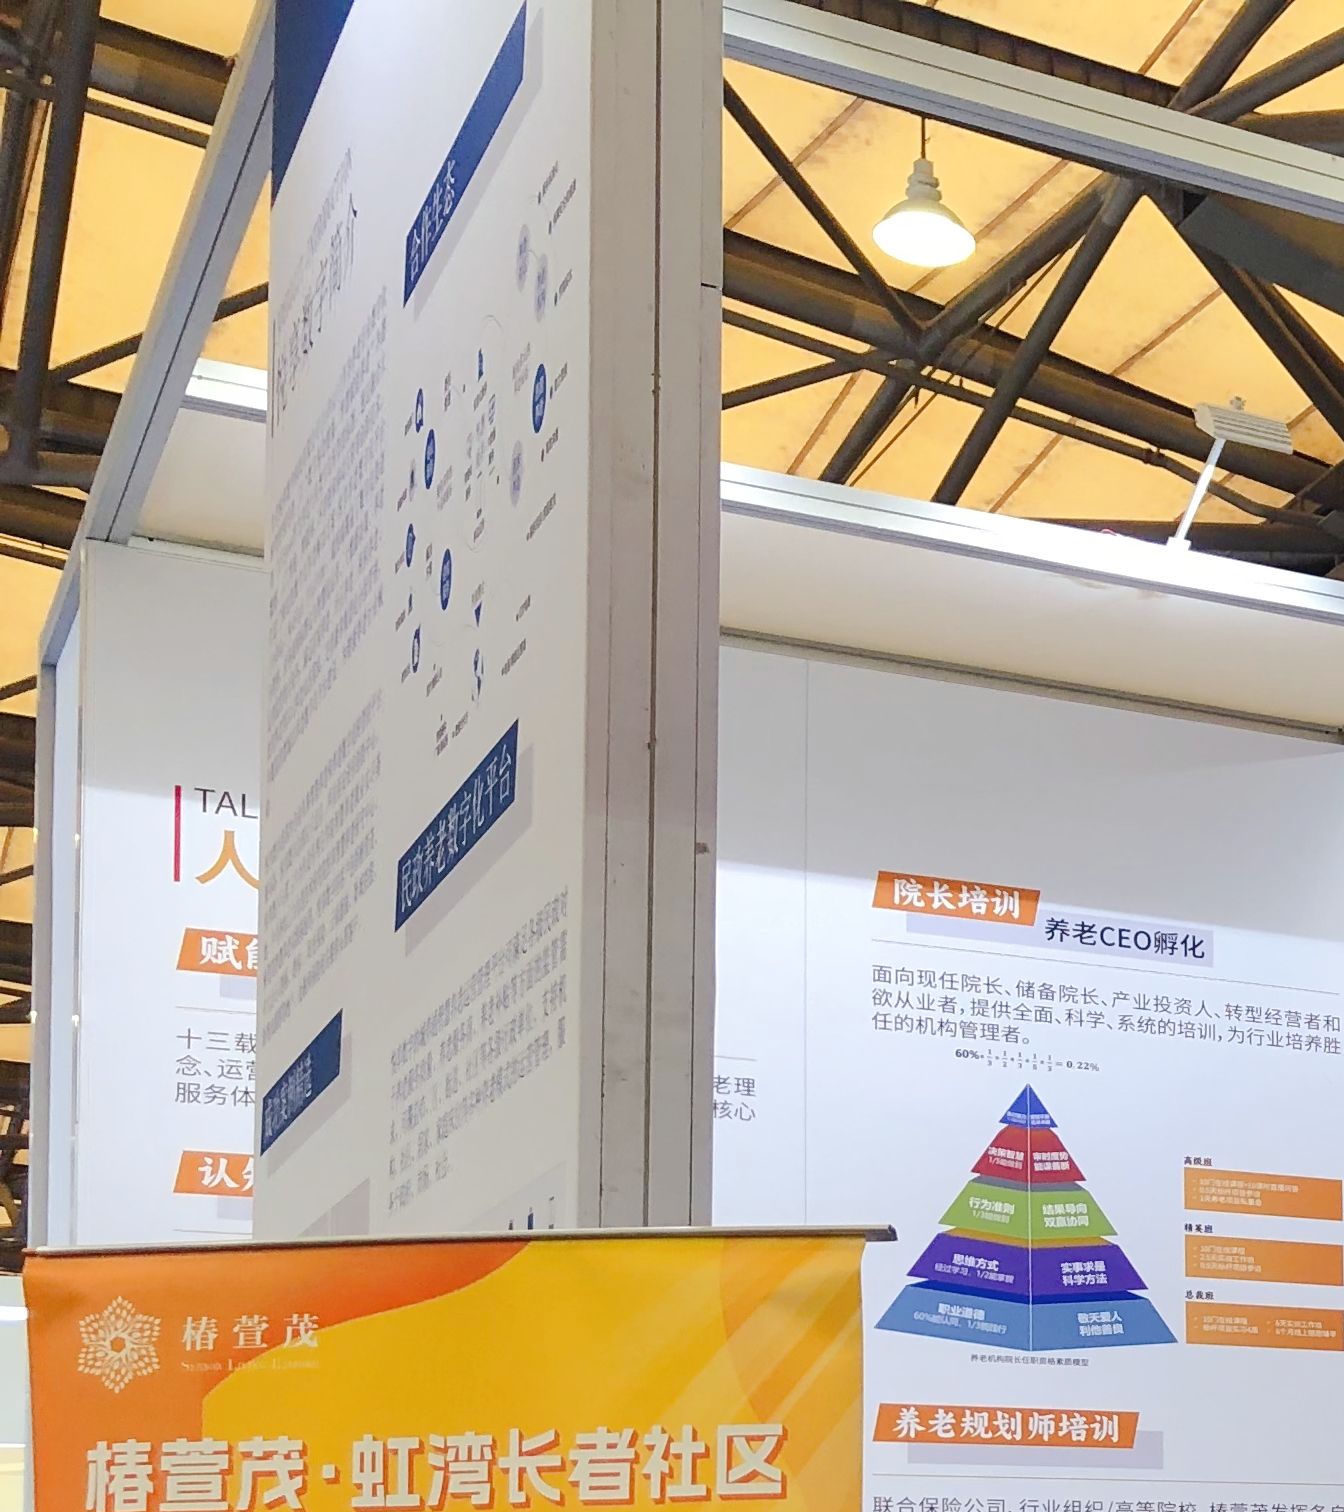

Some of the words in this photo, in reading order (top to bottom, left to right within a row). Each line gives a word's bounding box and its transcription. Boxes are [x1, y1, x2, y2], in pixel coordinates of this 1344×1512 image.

[401, 744, 512, 912] 民政养老数字化平台
[893, 877, 1021, 920] 院长培训
[1044, 916, 1206, 960] 养老CEO孵化
[871, 964, 1341, 1034] 面向现任院长、储备院长、产业投资人、转型经营者和
[871, 1011, 1032, 1046] 任的机构管理者。
[174, 1080, 255, 1106] 服务体
[712, 1099, 757, 1121] 核心
[713, 1074, 757, 1097] 老理
[951, 1253, 1000, 1272] 思维方式
[1060, 1260, 1107, 1273] 实事求是
[1061, 1273, 1108, 1287] 科学方法
[937, 1301, 986, 1321] 职业道德
[181, 1313, 320, 1352] 椿萱茂
[892, 1406, 1120, 1443] 养老规划师培训
